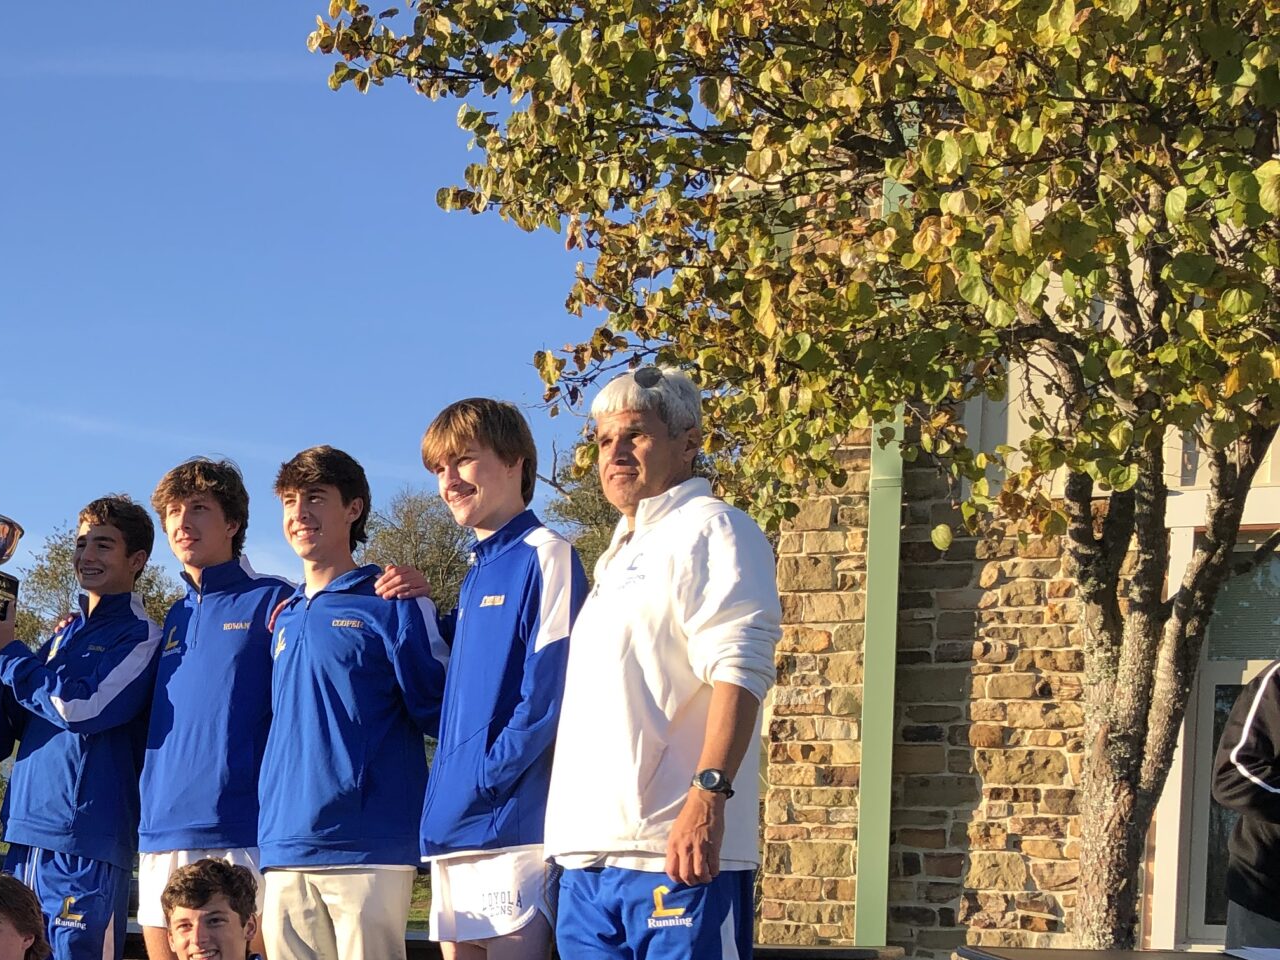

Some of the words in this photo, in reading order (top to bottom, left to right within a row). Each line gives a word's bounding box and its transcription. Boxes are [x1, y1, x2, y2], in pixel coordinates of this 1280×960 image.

[223, 622, 251, 631] ROWAN
[331, 619, 364, 629] COOPER
[482, 889, 523, 911] LOYOLA
[55, 917, 87, 931] Running
[647, 915, 693, 928] Running
